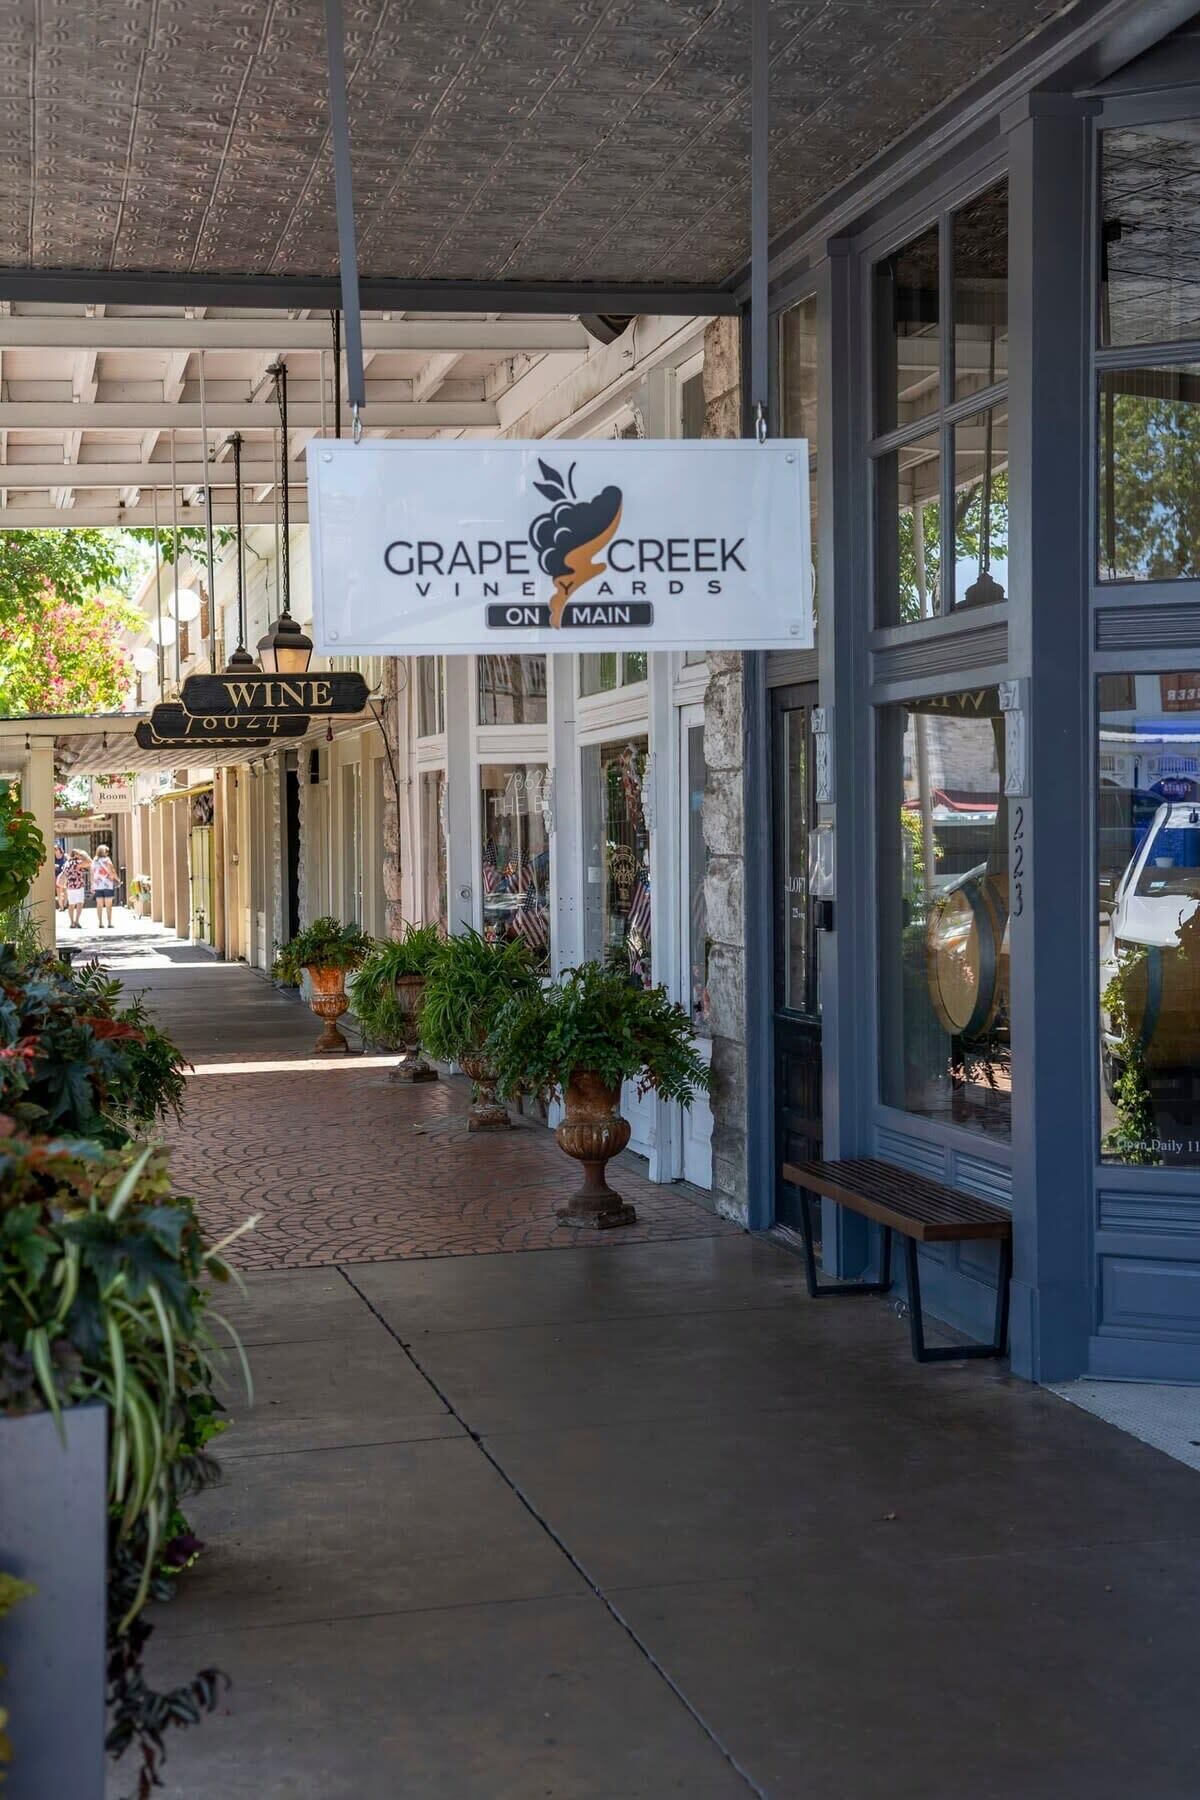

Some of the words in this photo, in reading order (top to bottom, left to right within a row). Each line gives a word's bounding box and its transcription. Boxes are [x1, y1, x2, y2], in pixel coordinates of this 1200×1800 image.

[383, 540, 530, 577] GRAPE
[606, 537, 748, 574] CREEK
[415, 580, 723, 597] VINEYARDS
[505, 606, 540, 626] ON
[571, 605, 631, 625] MAIN
[223, 681, 333, 708] WINE
[99, 792, 127, 801] Room
[1013, 806, 1024, 917] 223
[1117, 1138, 1147, 1151] Open
[1151, 1139, 1183, 1154] Daily
